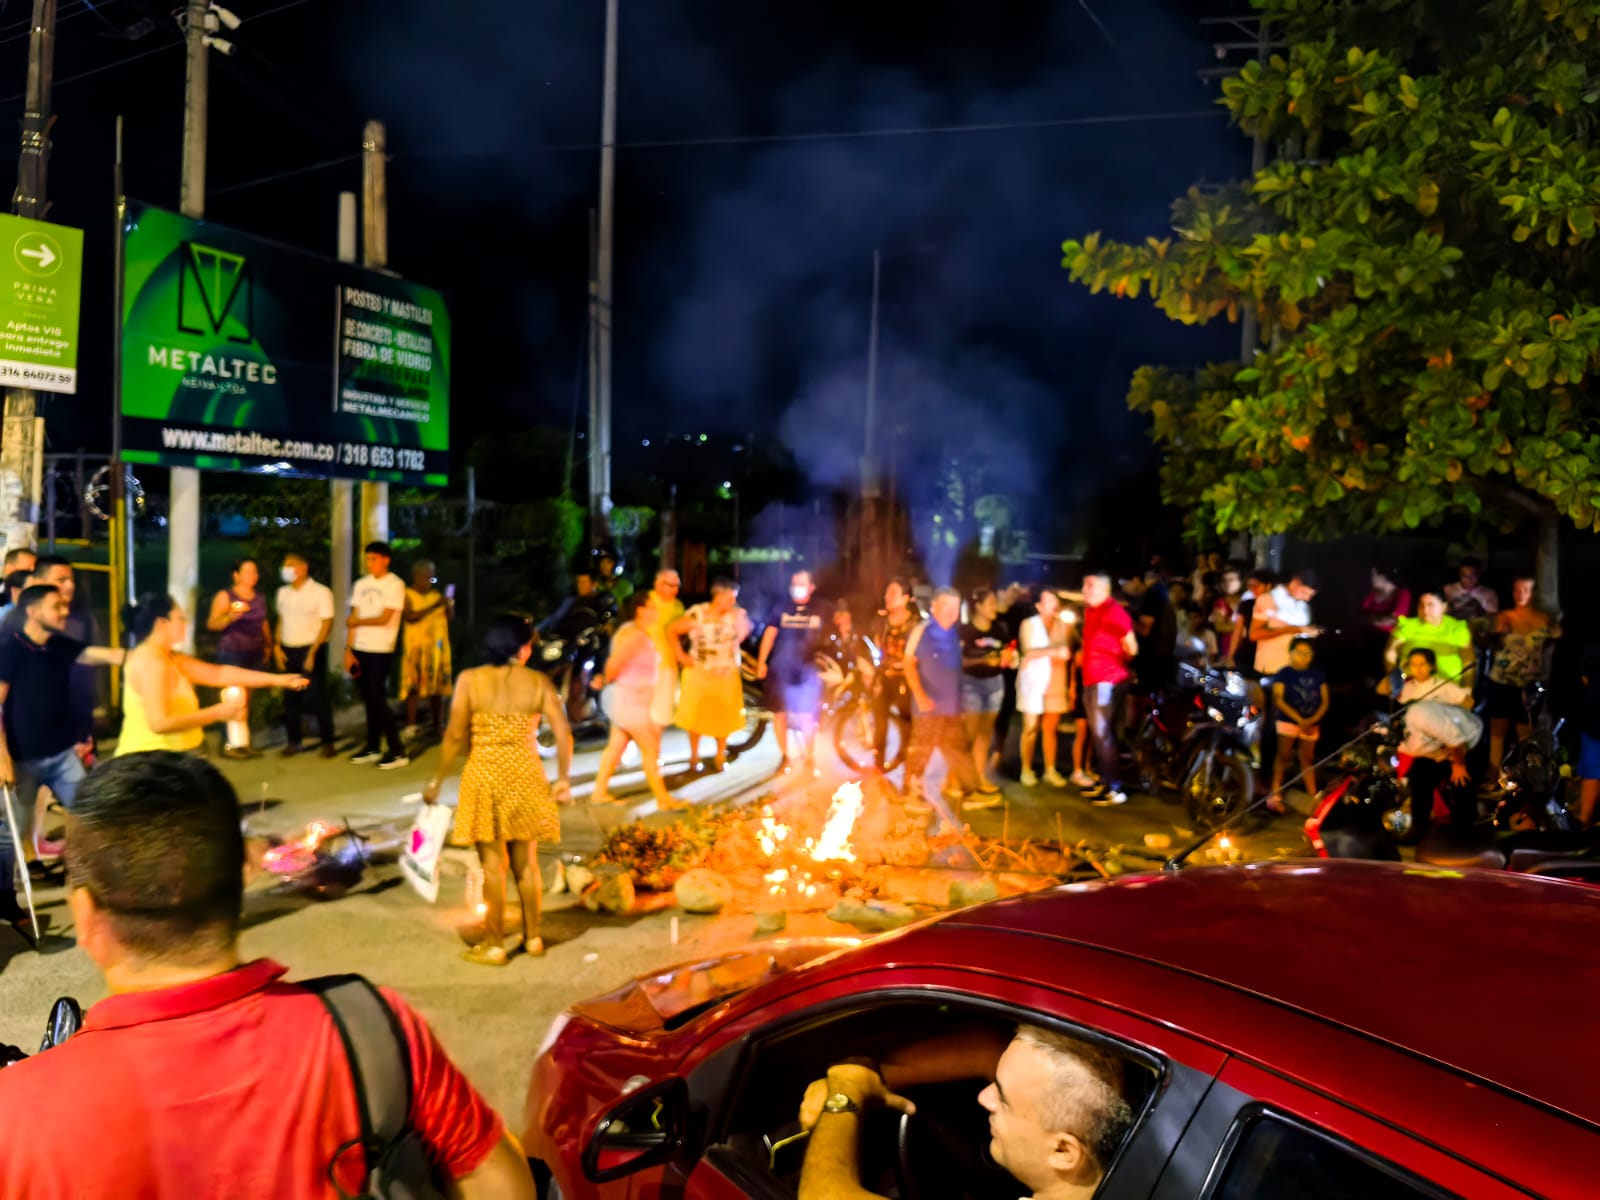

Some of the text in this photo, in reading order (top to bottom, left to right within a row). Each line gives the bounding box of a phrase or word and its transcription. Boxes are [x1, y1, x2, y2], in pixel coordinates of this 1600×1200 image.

[346, 287, 381, 312] POSTES
[383, 298, 391, 314] Y
[148, 344, 277, 384] METALTEC
[345, 339, 432, 372] FIBRA DE VIDRIO
[162, 427, 334, 461] www.metaltec.com.co
[344, 442, 369, 466] 318
[371, 446, 394, 468] 653
[396, 448, 425, 471] 1782
